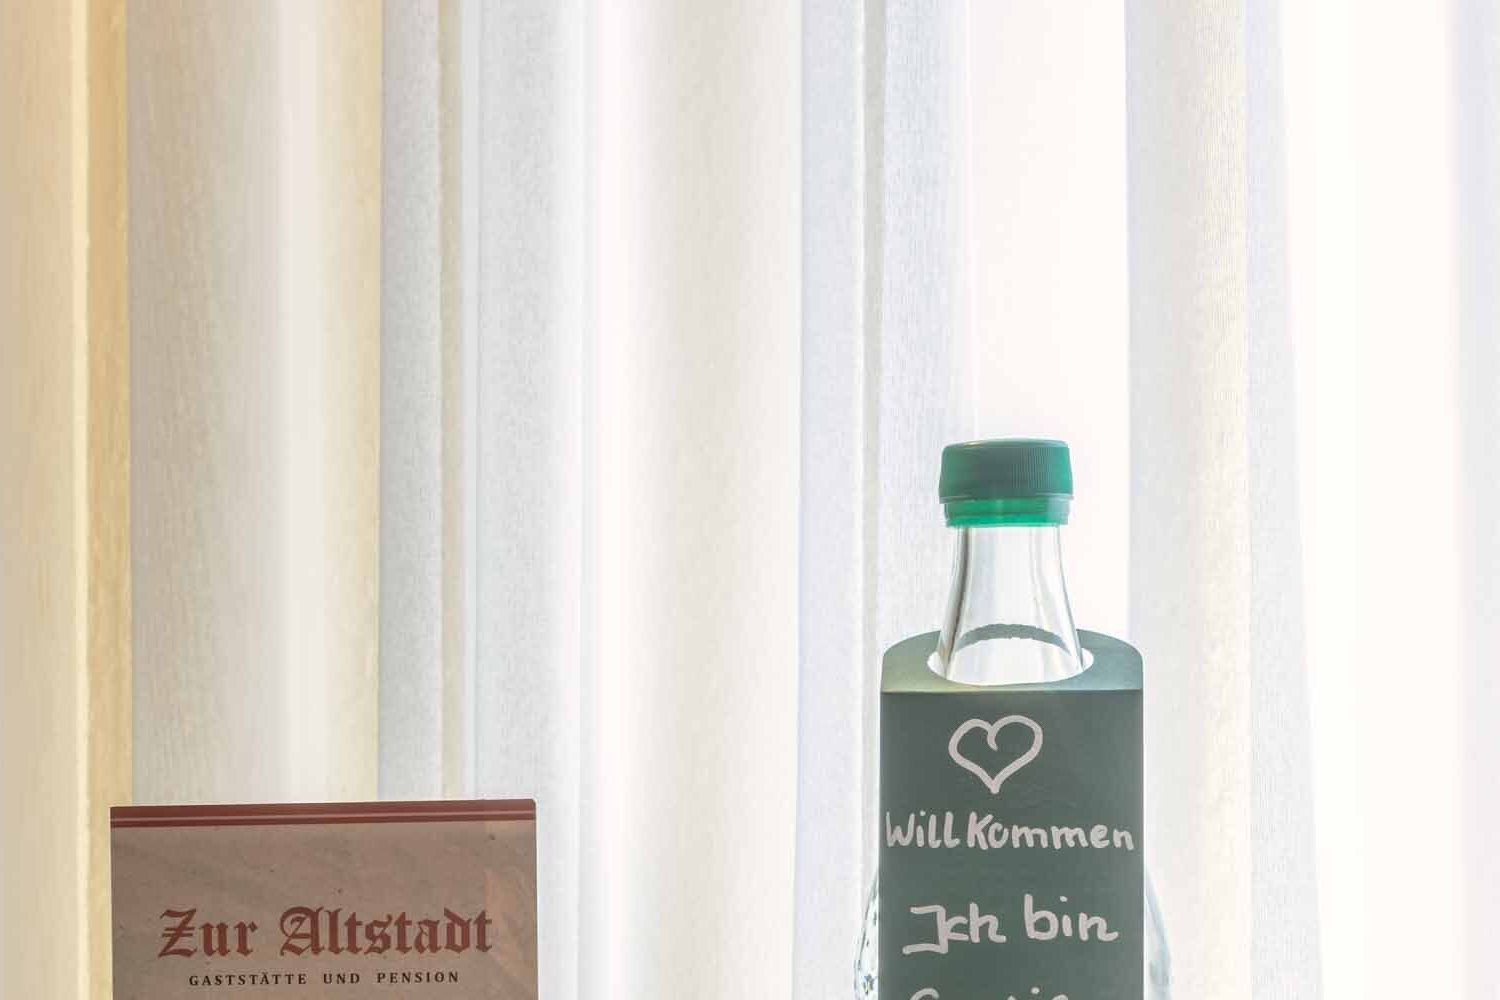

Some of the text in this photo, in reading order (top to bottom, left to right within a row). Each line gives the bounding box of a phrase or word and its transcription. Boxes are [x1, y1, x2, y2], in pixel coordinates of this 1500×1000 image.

[158, 905, 493, 958] Zur Altstadt
[1023, 893, 1119, 942] bin
[189, 970, 460, 987] GASTSTÄTTE UND PENSION
